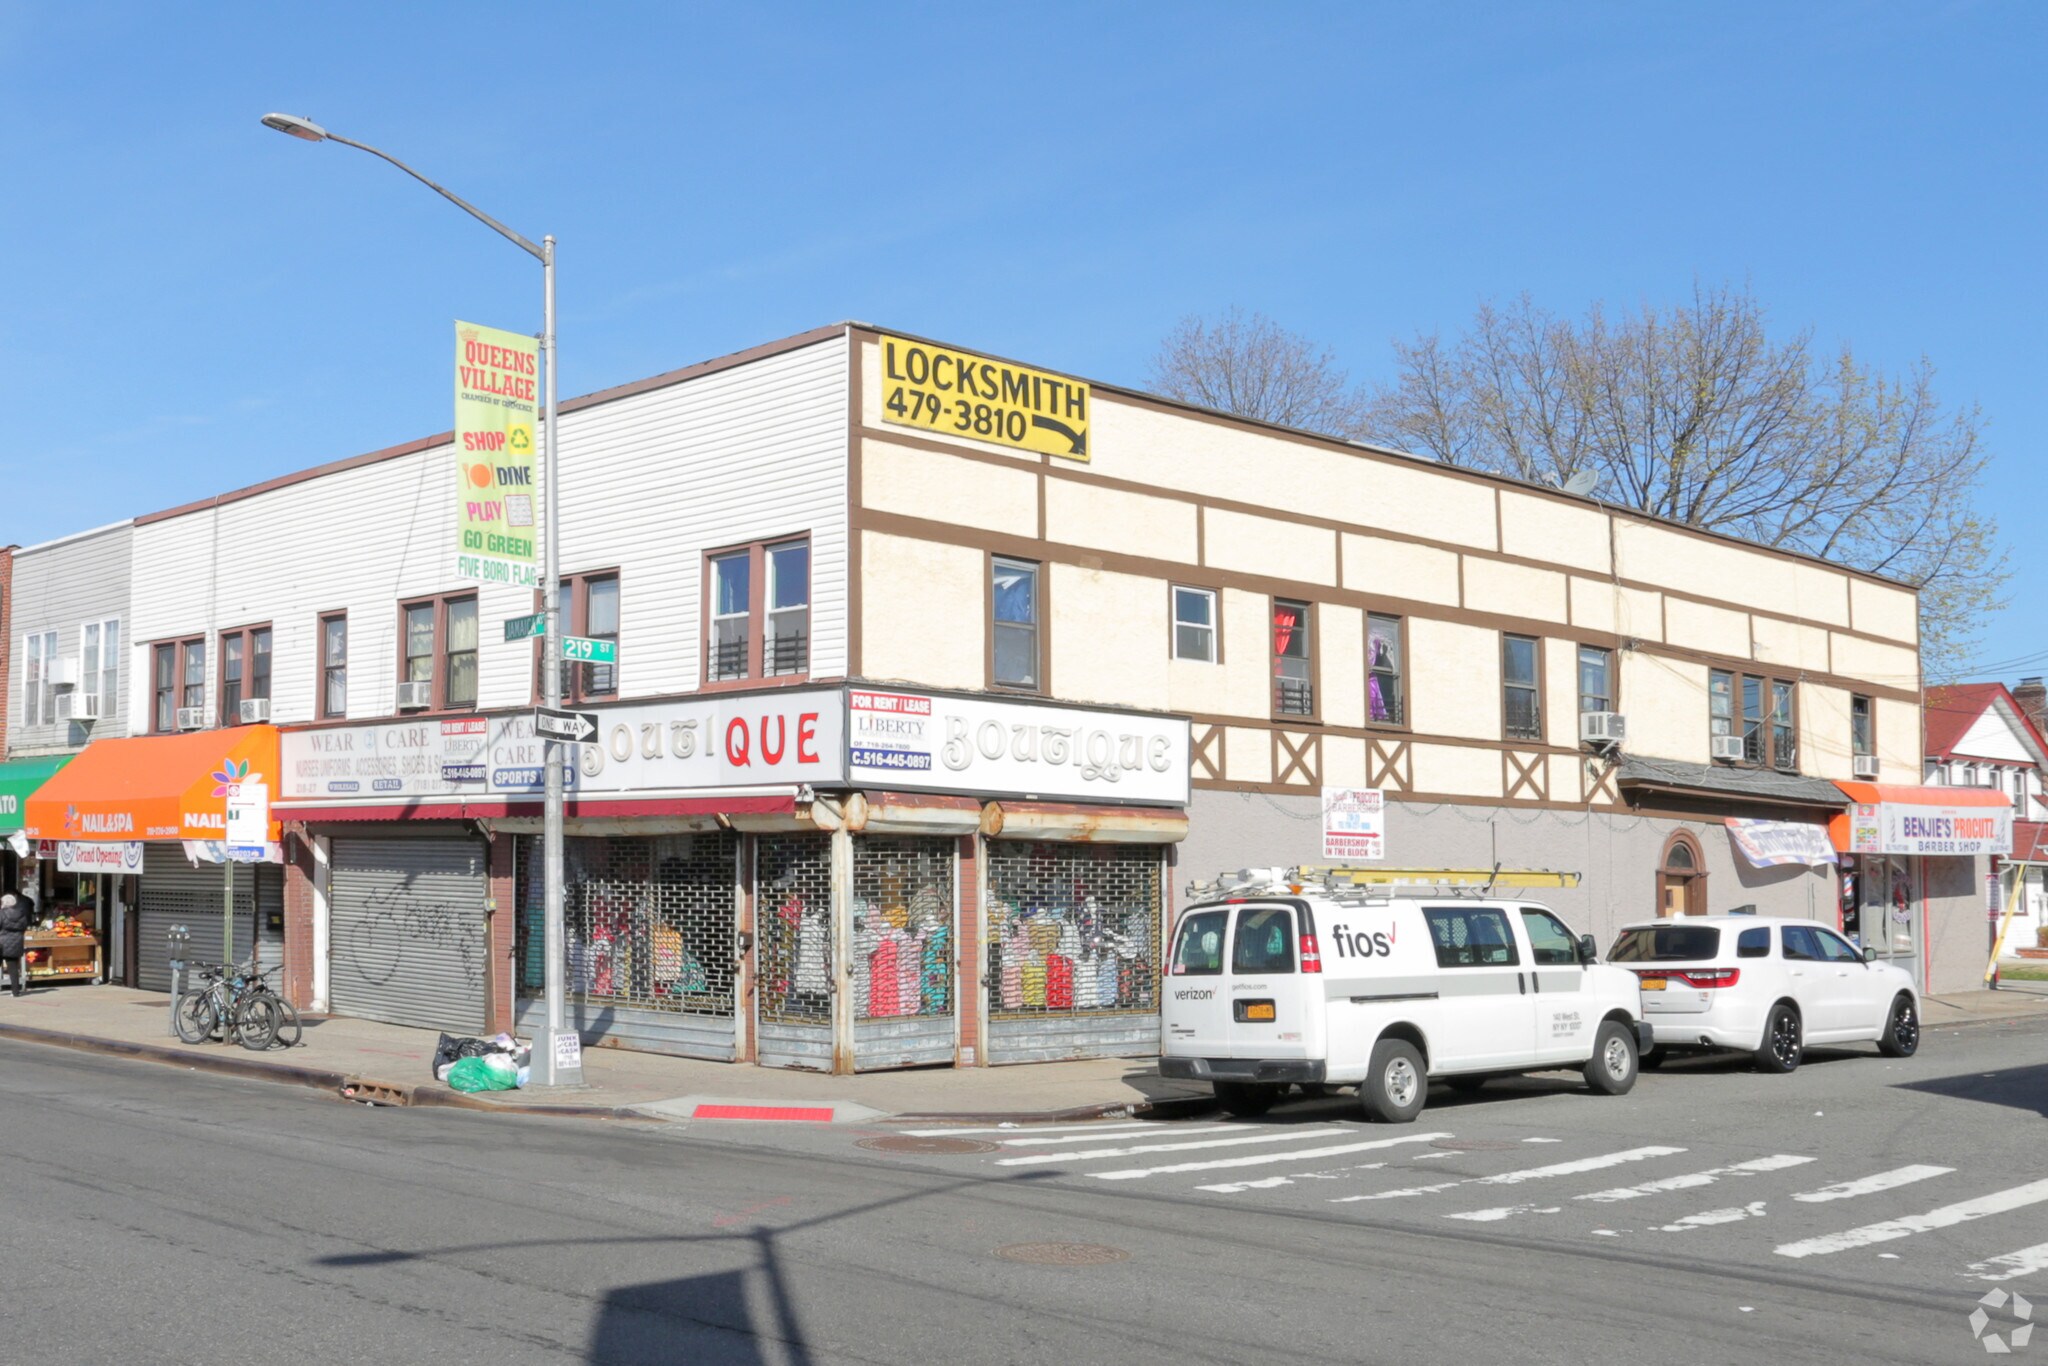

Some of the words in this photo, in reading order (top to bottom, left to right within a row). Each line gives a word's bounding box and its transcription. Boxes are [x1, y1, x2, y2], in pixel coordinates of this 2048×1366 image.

[465, 340, 534, 376] QUEENS
[460, 365, 535, 402] VILLAGE
[886, 342, 1085, 421] LOCKSMITH
[461, 392, 492, 404] CHAMBER
[502, 400, 533, 412] COMMERCE
[886, 387, 1027, 442] 479-3810
[463, 431, 506, 451] SHOP
[497, 466, 532, 485] DINE
[467, 501, 501, 522] PLAY
[464, 529, 482, 549] GO
[487, 533, 532, 558] GREEN
[458, 555, 480, 578] FIVE
[484, 560, 509, 583] BORO
[513, 564, 537, 587] FLAG
[506, 621, 537, 639] JAMAICA
[565, 640, 593, 658] 219
[600, 643, 610, 653] ST
[852, 694, 872, 709] FOR
[873, 696, 898, 711] RENT
[903, 699, 930, 713] LEASE
[501, 720, 536, 739] WEA
[542, 717, 554, 731] ONE
[563, 721, 586, 733] WAY
[859, 714, 925, 735] LIBERTY
[311, 733, 354, 753] WEAR
[386, 728, 430, 749] CARE
[444, 737, 481, 752] LIBERTY
[940, 715, 1172, 783] BOUTIQUE
[494, 745, 536, 765] CARE
[852, 751, 930, 768] C.516-445-0897
[296, 759, 319, 778] NURSES
[402, 754, 426, 775] SHOES
[373, 779, 400, 790] RETAIL
[495, 770, 537, 785] SPORTS
[82, 813, 134, 832] NAIL&SPA
[1903, 817, 1951, 838] BENJIE'S
[1954, 818, 1994, 838] PROCUTZ
[1326, 838, 1369, 847] BARBERSHOP
[1334, 848, 1345, 856] THE
[1347, 848, 1368, 857] BLOCK
[1918, 841, 1955, 851] BARBER
[1959, 841, 1981, 851] SHOP
[75, 846, 95, 863] Grand
[95, 847, 122, 868] Opening
[1332, 924, 1391, 958] fios
[1175, 987, 1212, 1000] verizon
[1232, 983, 1268, 991] getfios.com
